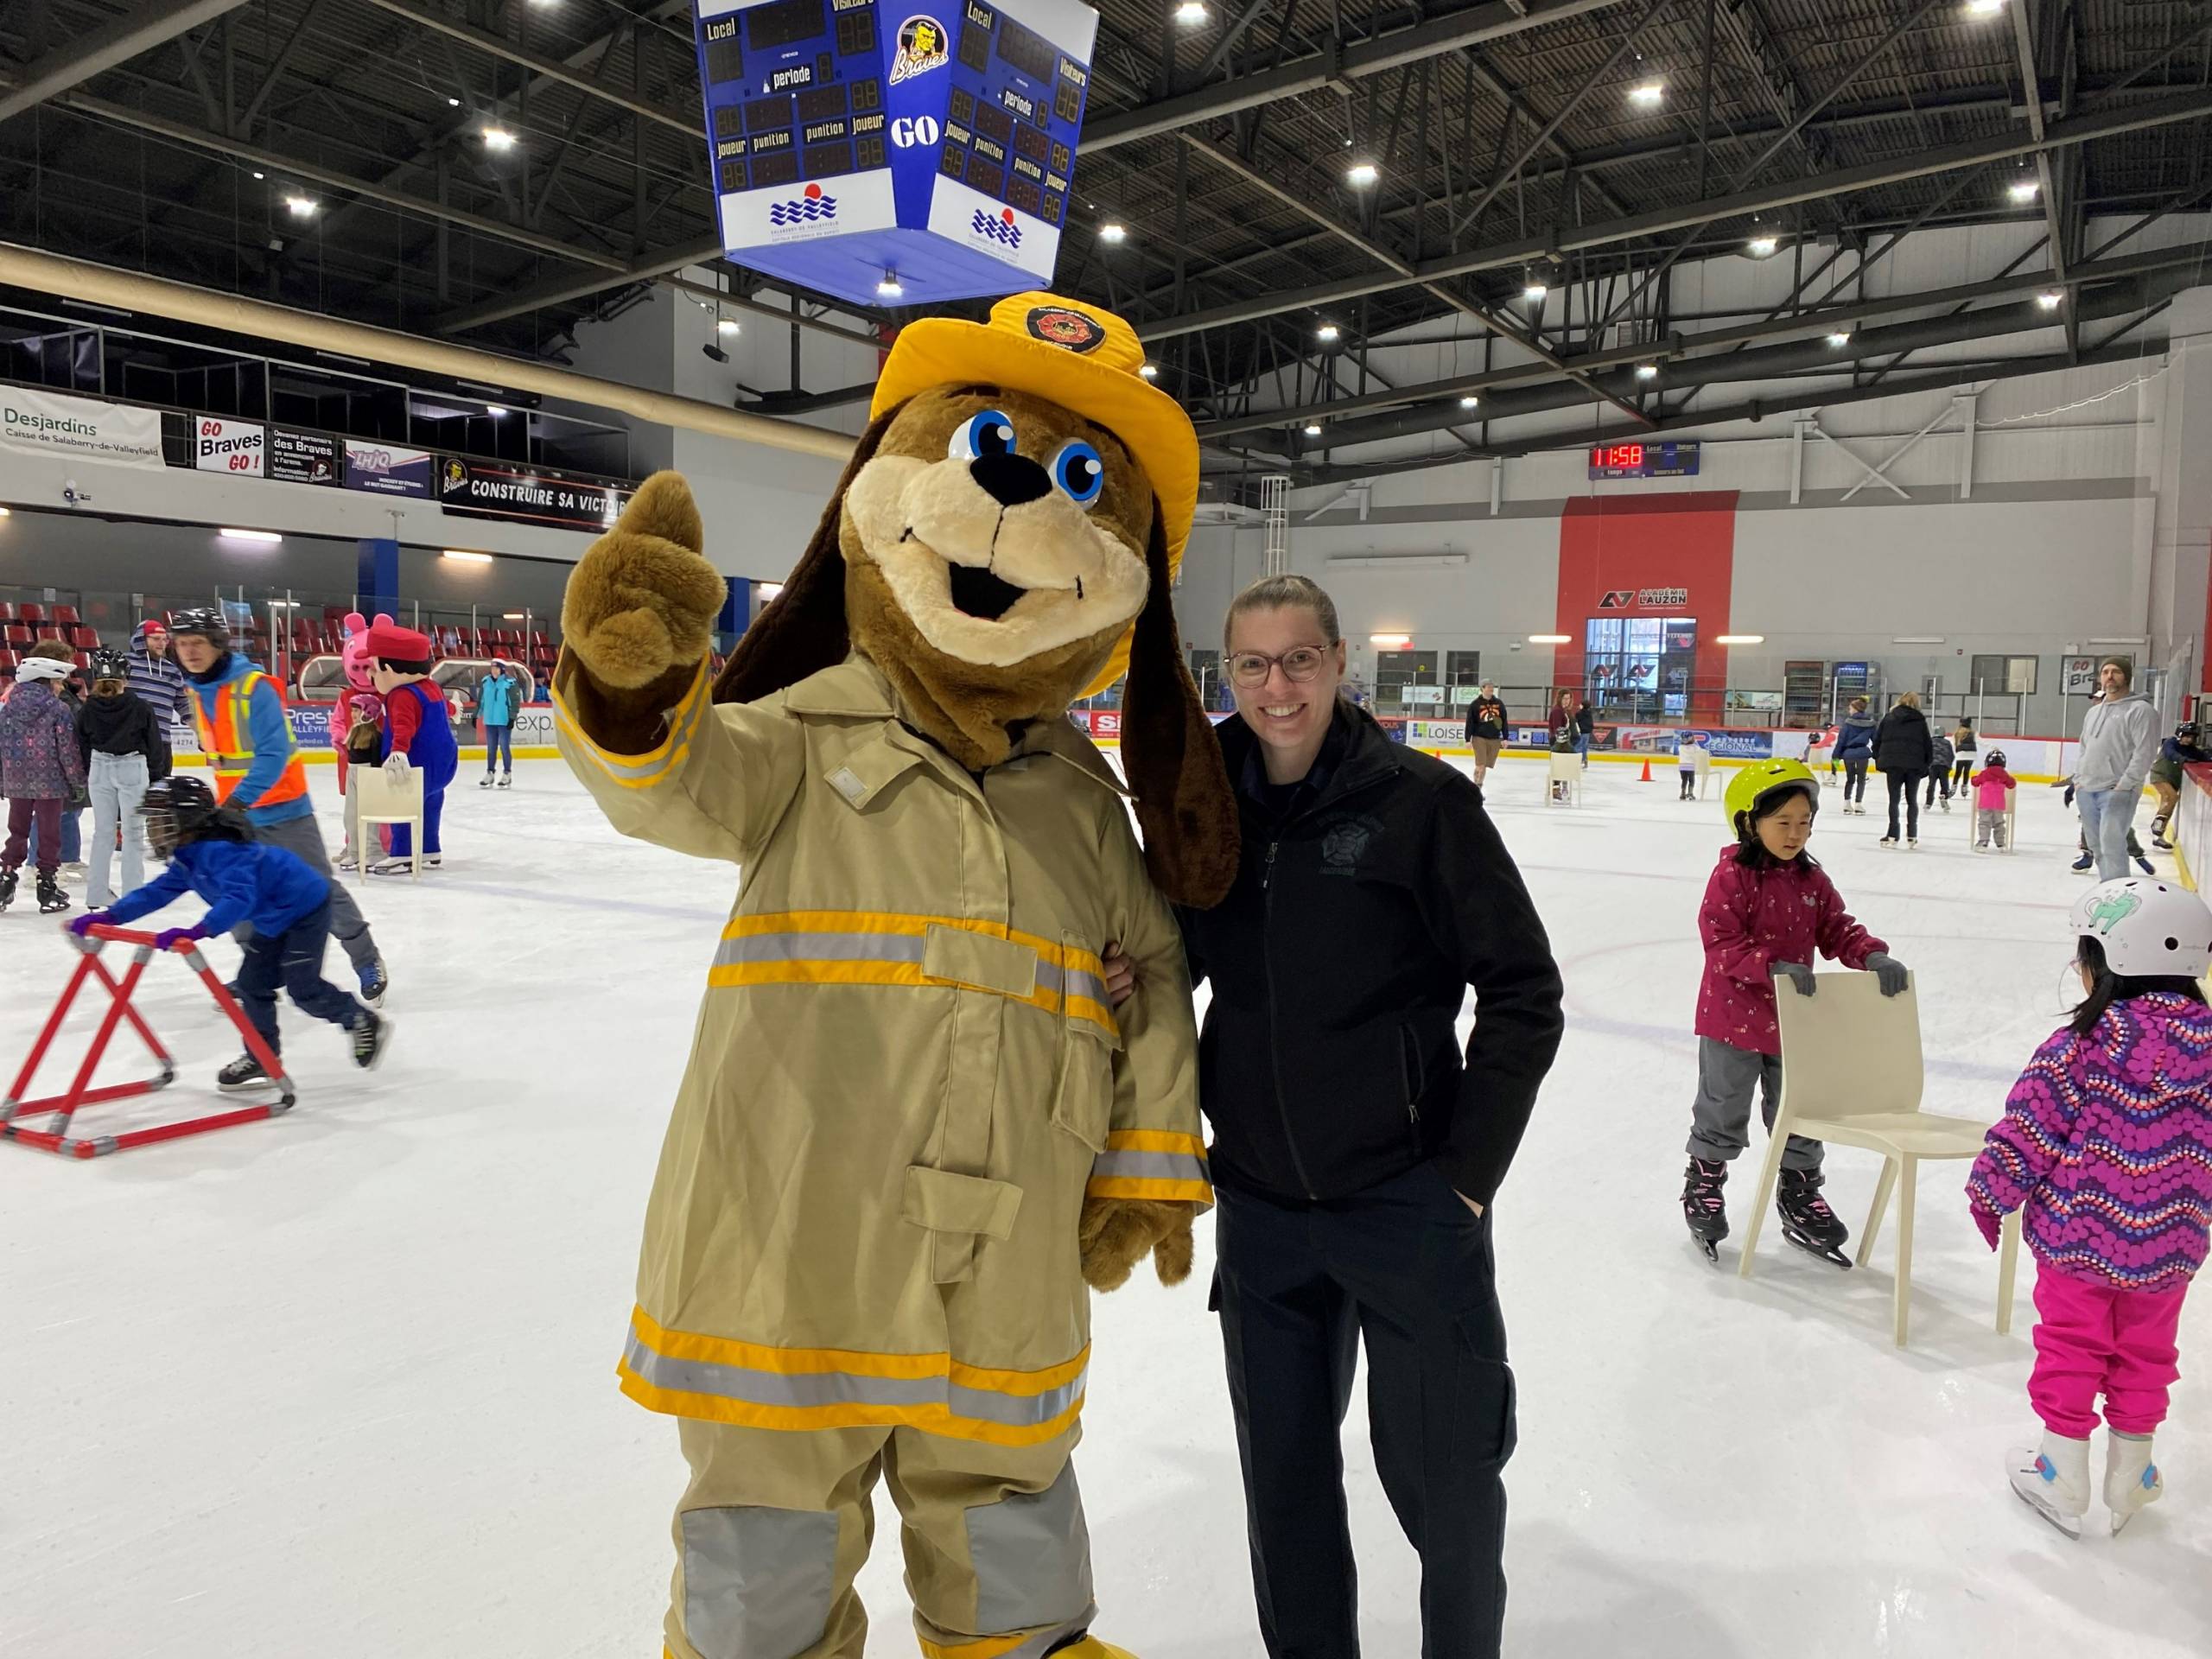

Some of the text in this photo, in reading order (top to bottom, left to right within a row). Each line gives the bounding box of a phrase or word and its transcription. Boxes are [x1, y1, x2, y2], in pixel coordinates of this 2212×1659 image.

[967, 1, 993, 30] Local
[707, 18, 736, 41] Local
[890, 47, 948, 84] Braves
[806, 123, 844, 143] punition
[852, 114, 885, 136] joueur
[891, 116, 939, 148] GO
[944, 120, 971, 144] joueur
[717, 140, 747, 160] joueur
[753, 132, 790, 152] punition
[975, 137, 1004, 160] punition
[1014, 156, 1041, 180] punition
[1045, 171, 1067, 193] joueur
[4, 407, 97, 436] Desjardins
[201, 421, 222, 436] GO
[5, 428, 158, 456] Caisse de Salaberry-de-Valleyfield
[200, 435, 262, 456] Braves
[274, 438, 333, 455] des Braves
[229, 454, 250, 470] GO
[1597, 446, 1642, 466] 11:58
[471, 480, 554, 505] CONSTRUIRE
[558, 493, 575, 508] SA
[1641, 588, 1688, 596] ACADÉMIE
[516, 715, 553, 744] exp.
